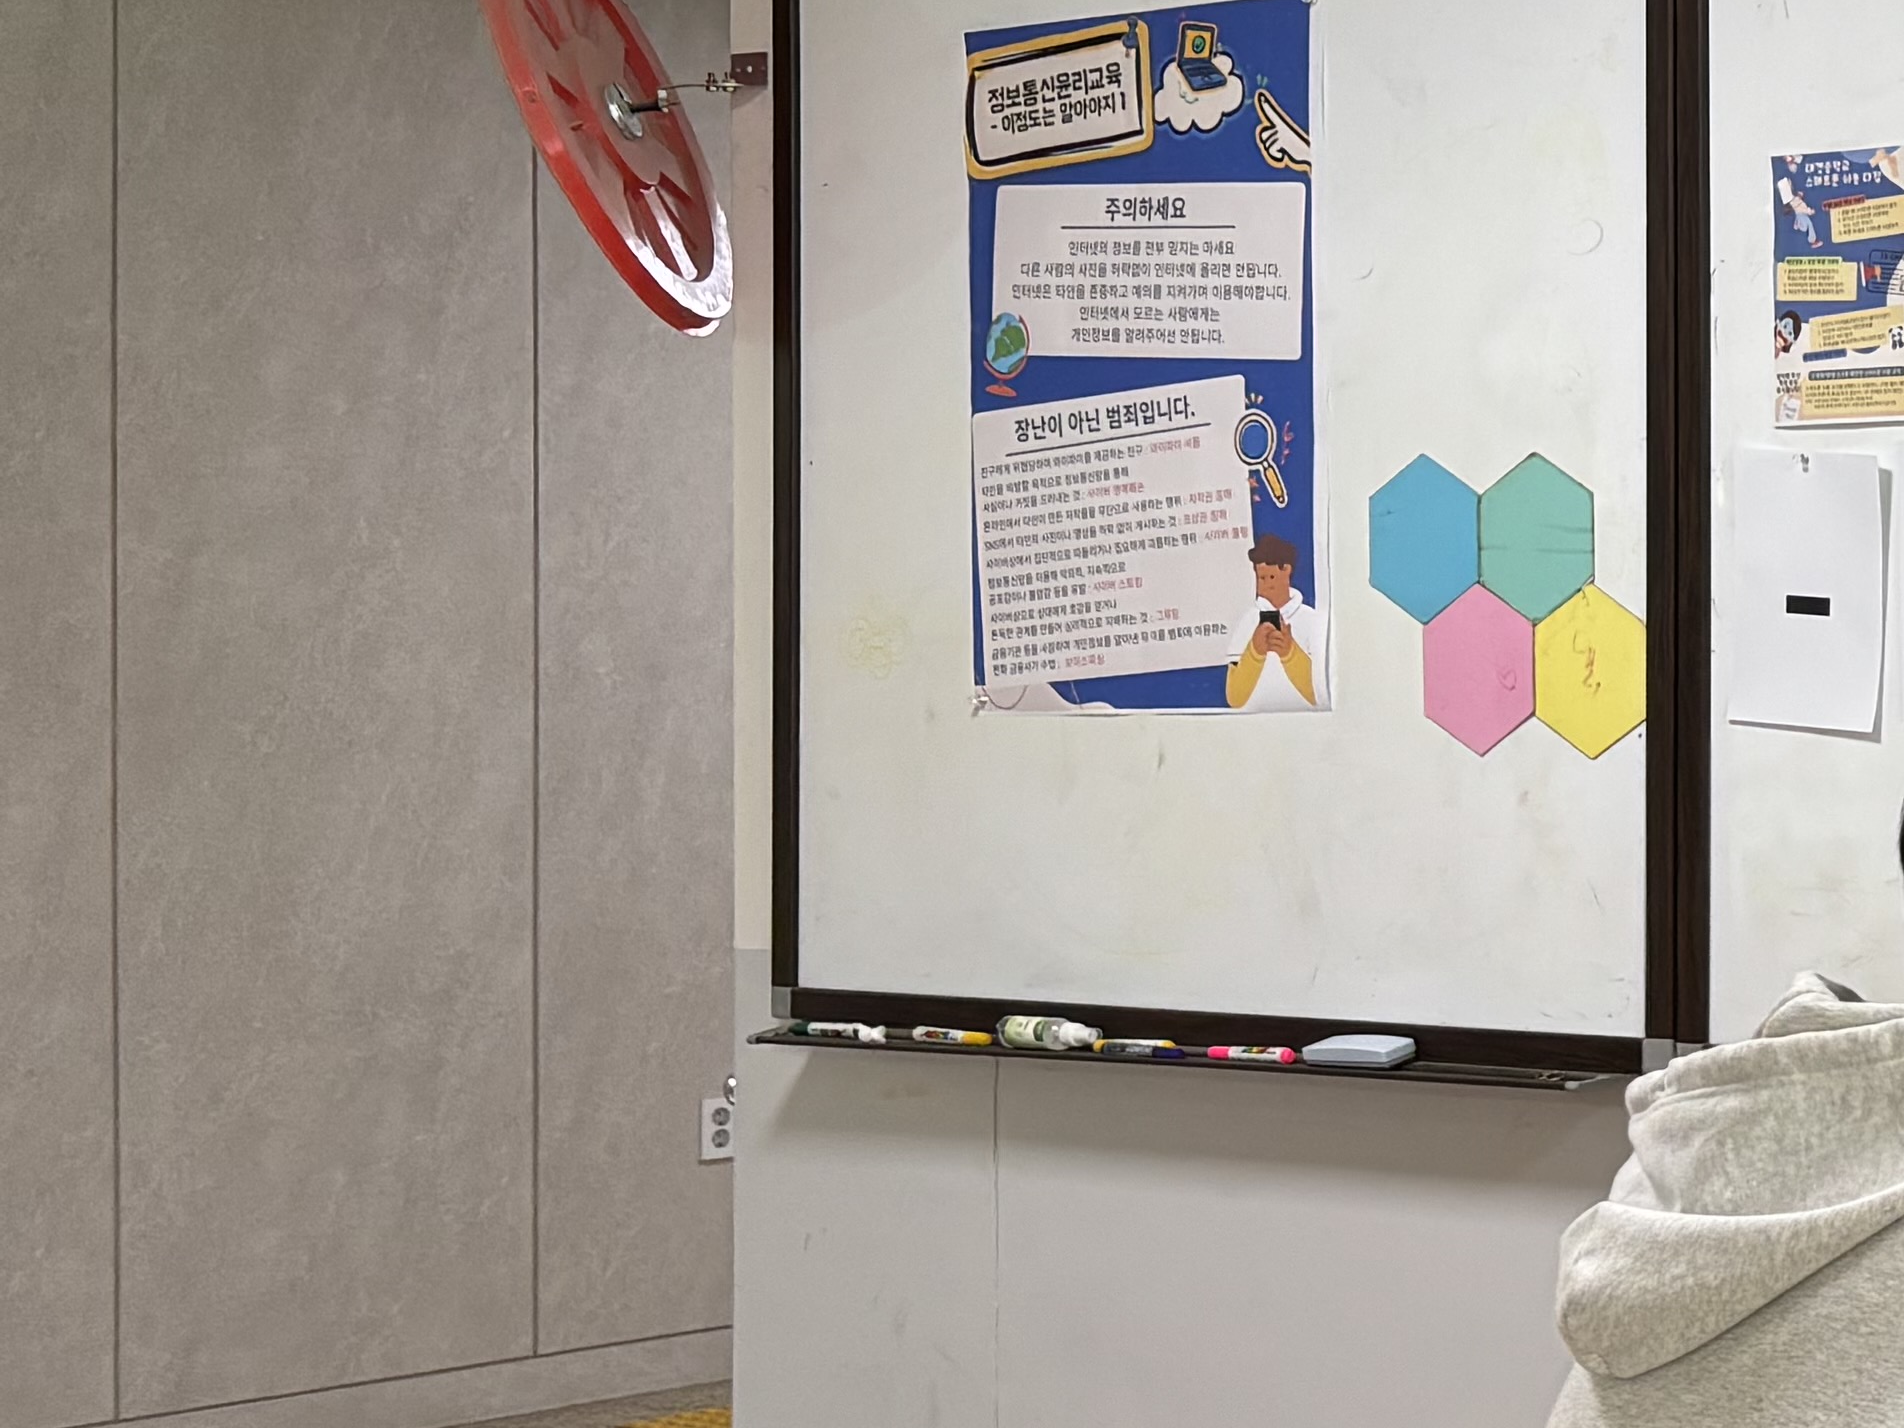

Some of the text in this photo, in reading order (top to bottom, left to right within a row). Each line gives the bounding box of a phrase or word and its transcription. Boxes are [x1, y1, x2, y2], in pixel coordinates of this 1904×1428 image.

[987, 62, 1123, 114] 정보통신윤리교육
[1001, 107, 1056, 135] 이정도는
[1104, 196, 1187, 222] 주의하세요
[1014, 395, 1196, 443] 장난이 아닌 범죄입니다.
